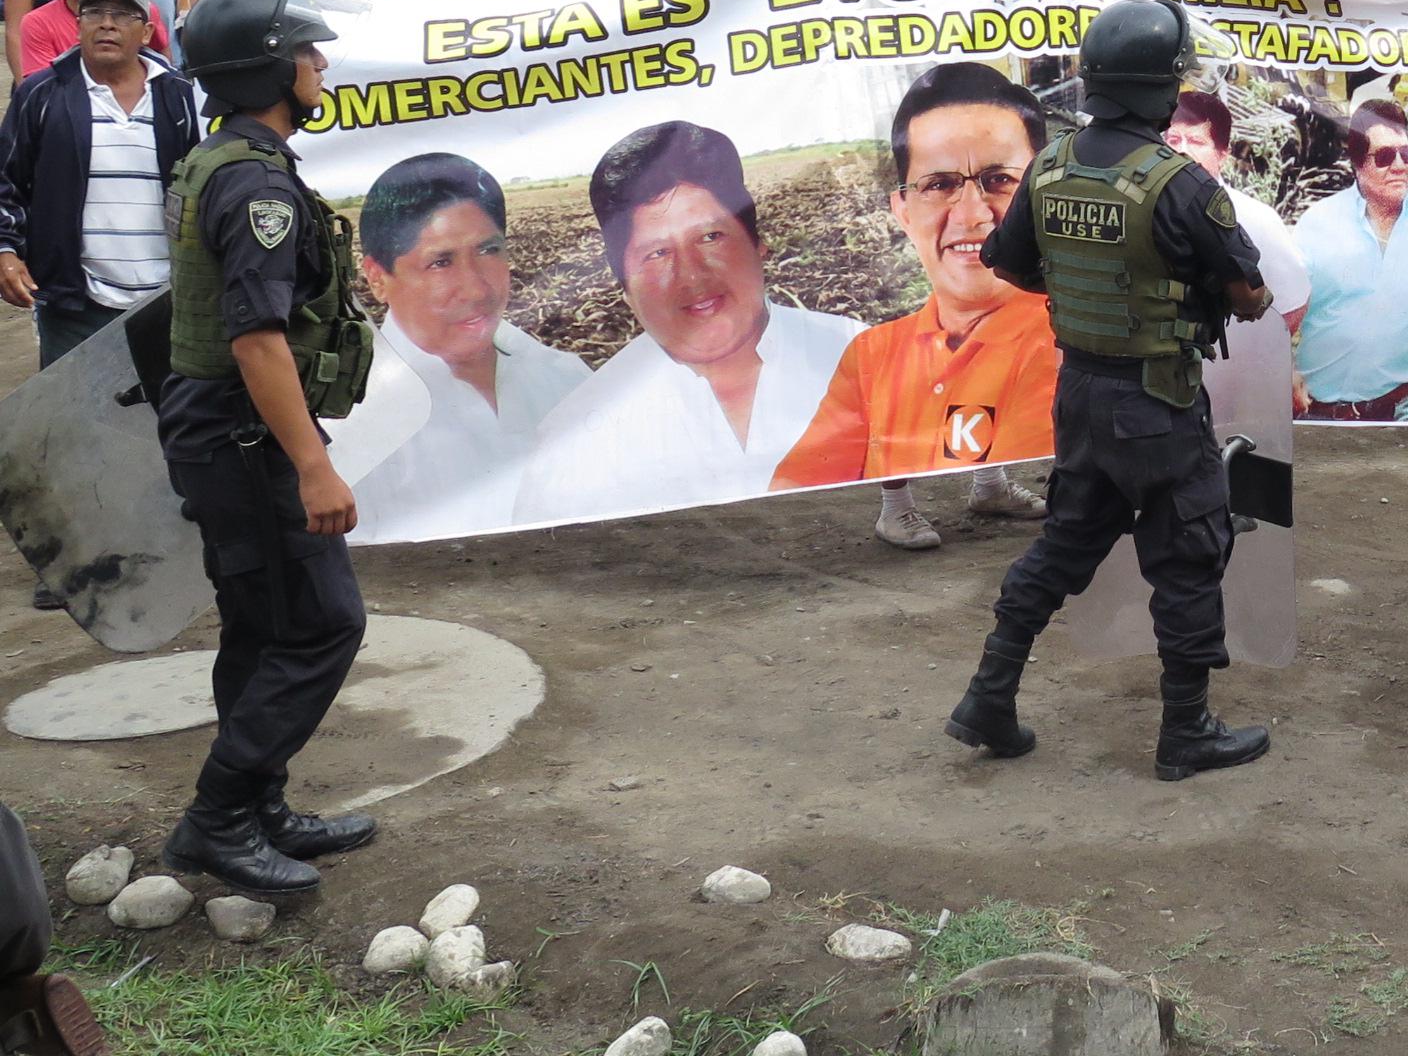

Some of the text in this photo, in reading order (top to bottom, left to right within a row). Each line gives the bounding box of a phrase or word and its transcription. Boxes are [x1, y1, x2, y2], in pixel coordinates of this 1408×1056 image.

[424, 1, 607, 64] ESTA
[301, 40, 715, 134] OMERCIANTES,
[1045, 198, 1120, 227] POLICIA
[1062, 223, 1102, 238] USE
[951, 413, 984, 453] K
